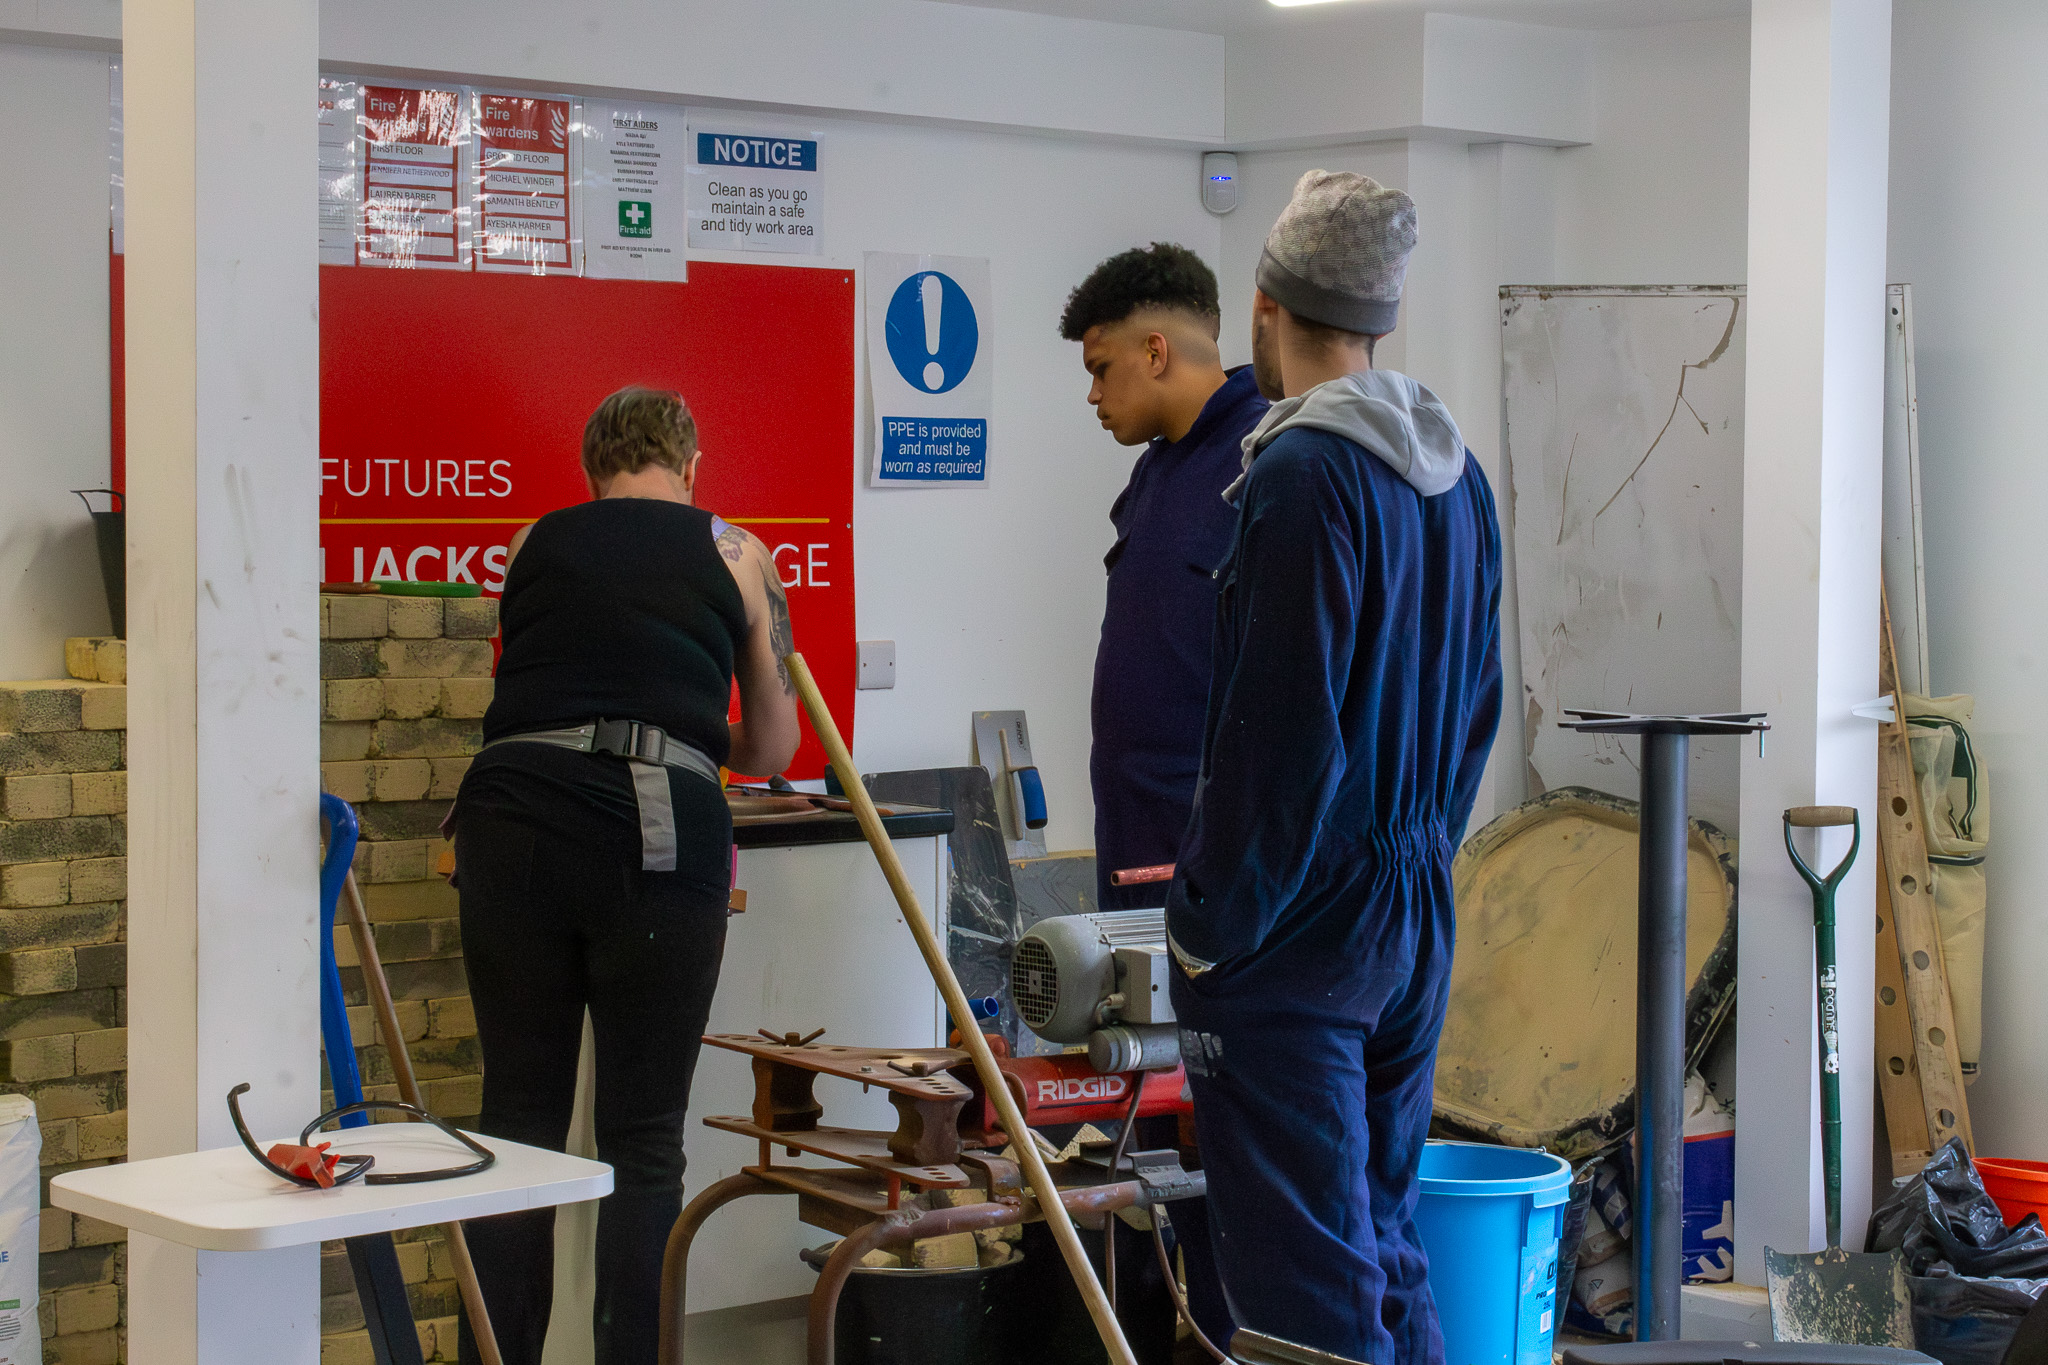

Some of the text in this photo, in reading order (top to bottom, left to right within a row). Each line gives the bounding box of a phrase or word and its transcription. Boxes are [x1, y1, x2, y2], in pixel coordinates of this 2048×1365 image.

[370, 98, 396, 112] Fire
[486, 106, 510, 121] Fire
[612, 118, 659, 130] FIRST AIDERS
[485, 125, 539, 140] wardens
[371, 144, 424, 156] FIRST FLOOR
[486, 151, 550, 164] GROD FLOOR
[713, 137, 802, 167] NOTICE
[486, 174, 555, 186] MICHAEL WINDER
[370, 189, 437, 202] LAUREN BARBER
[707, 181, 808, 204] Clean as you go
[486, 197, 560, 209] SAMANTH BENTLEY
[711, 200, 805, 219] maintain a safe
[486, 219, 552, 231] AYESHA HARMER
[619, 225, 652, 235] First aid
[700, 217, 814, 236] and tidy work area
[888, 421, 981, 441] PPE is provided
[898, 440, 971, 456] and must be
[884, 459, 982, 477] worn as required
[319, 458, 513, 497] FUTURES
